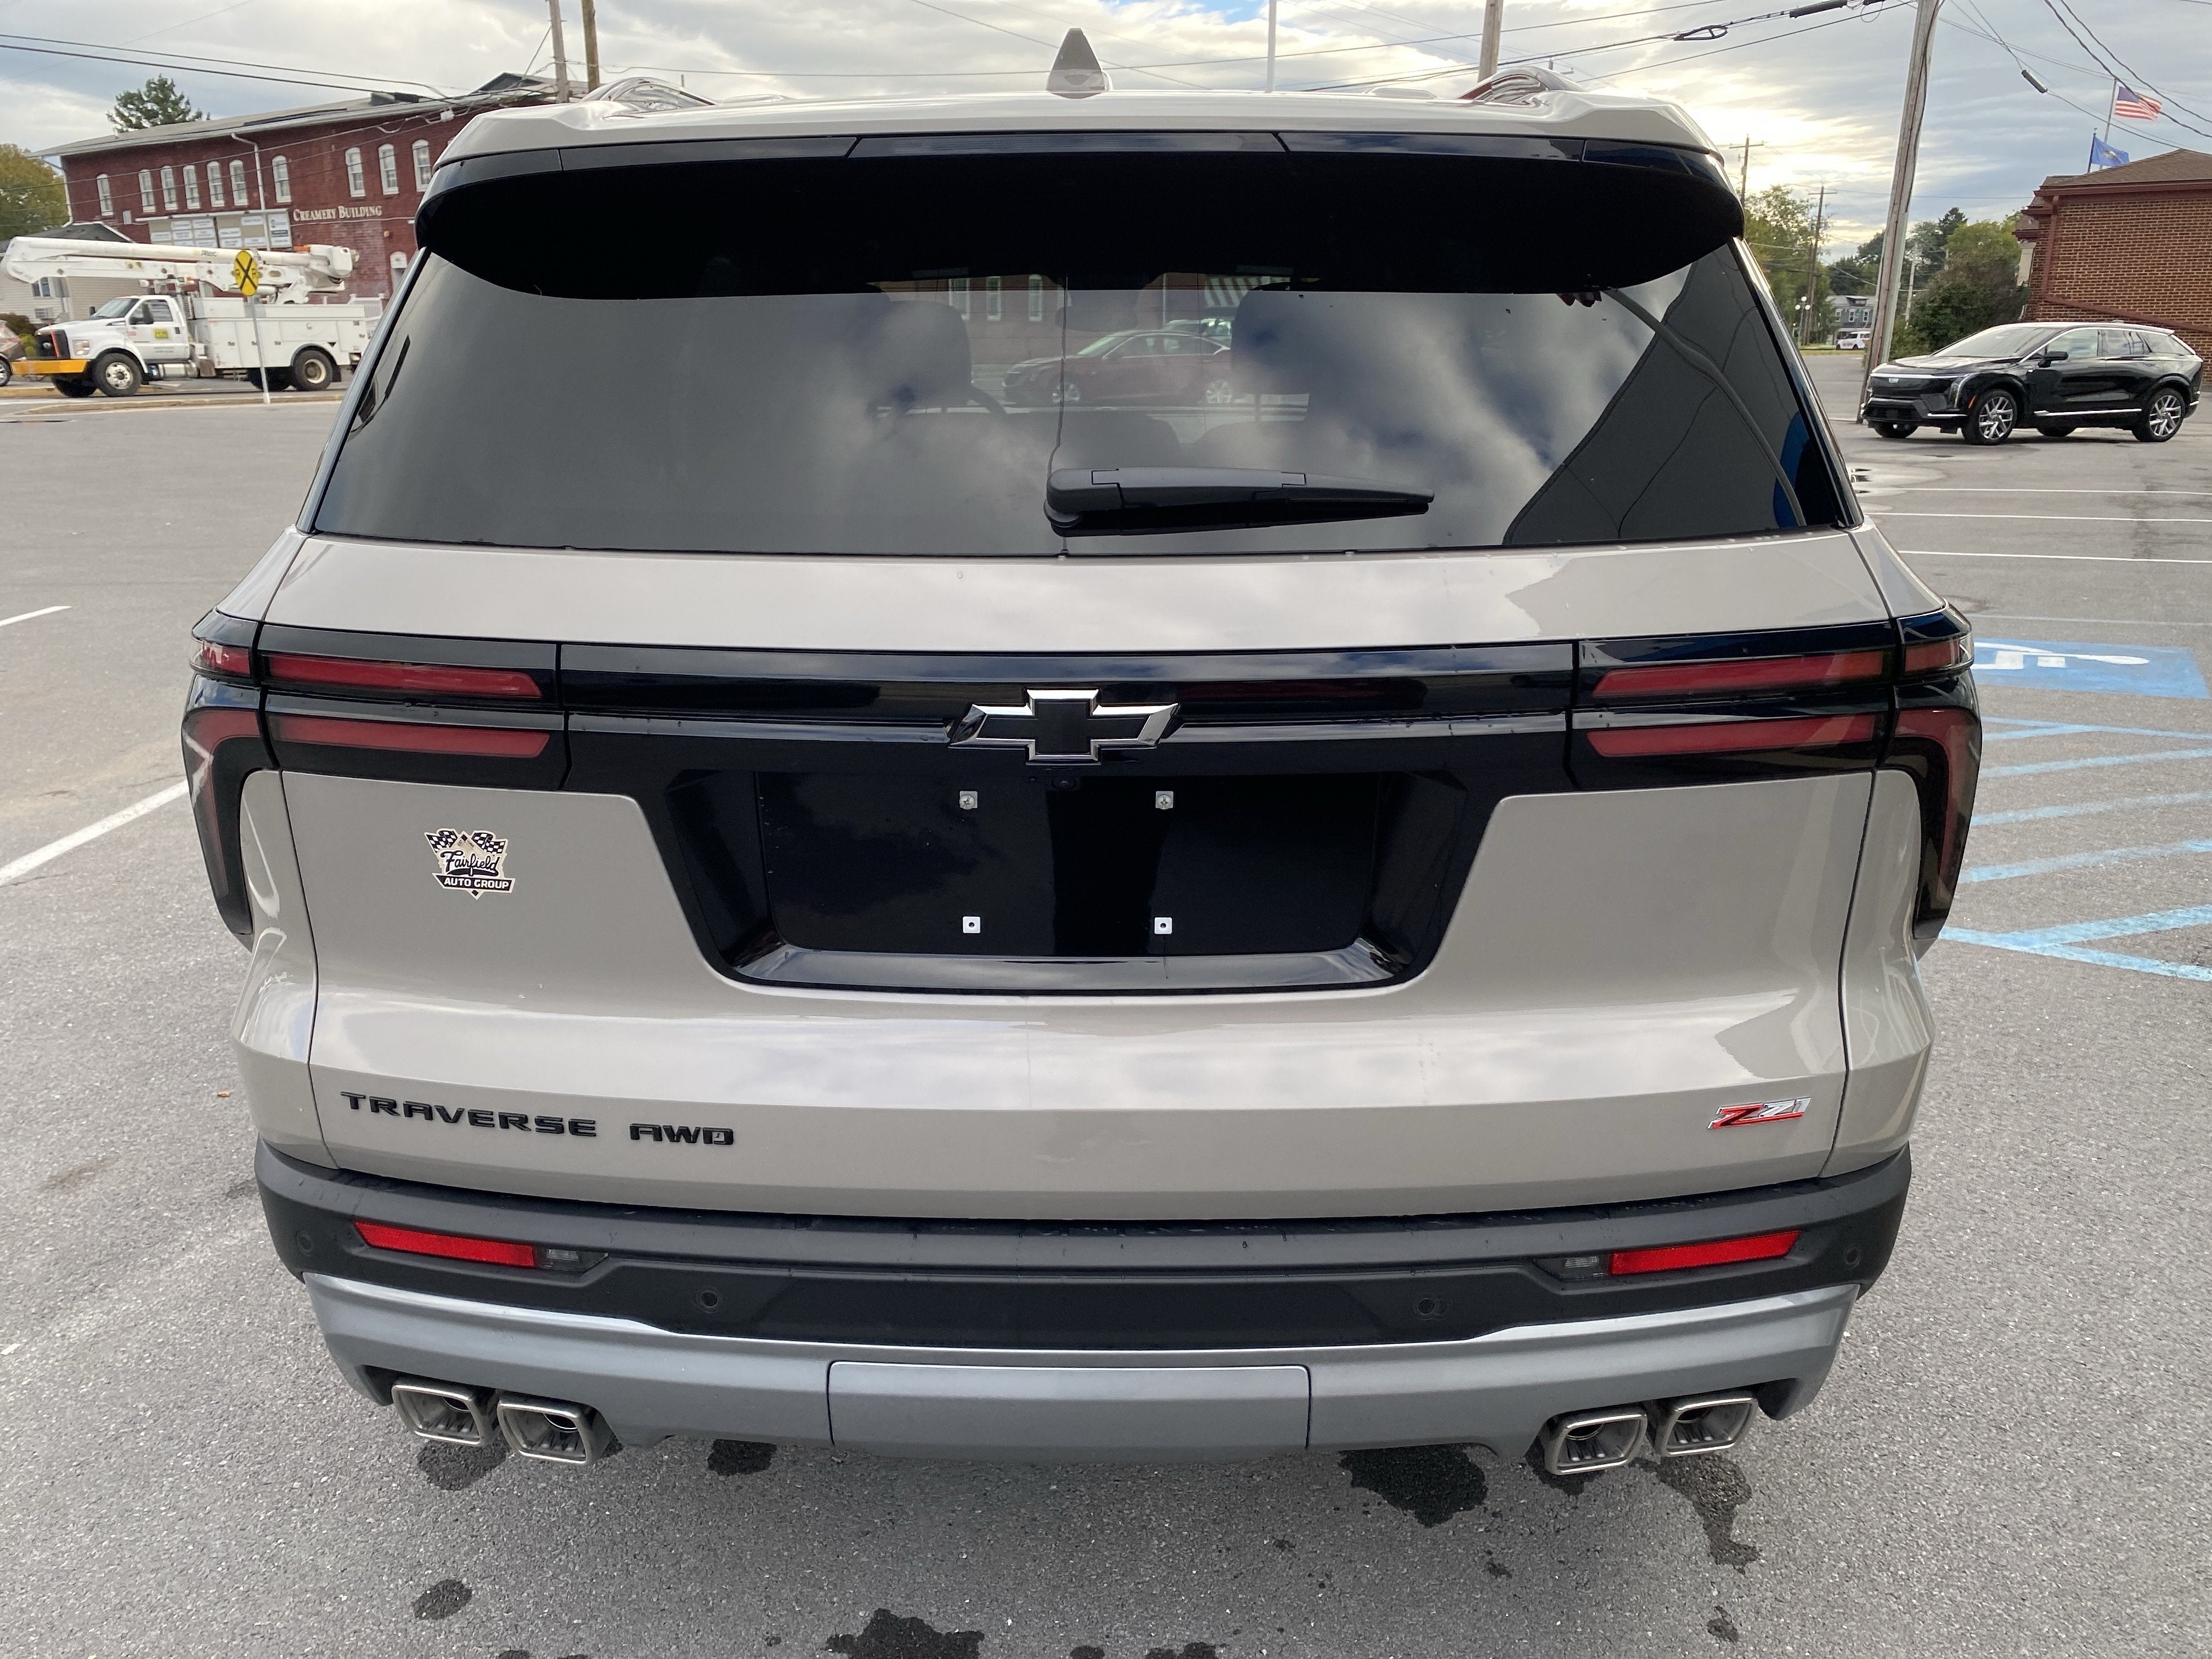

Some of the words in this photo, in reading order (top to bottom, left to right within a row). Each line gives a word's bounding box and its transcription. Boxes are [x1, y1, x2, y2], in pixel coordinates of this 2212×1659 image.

[337, 205, 382, 218] BUILDING
[440, 850, 500, 873] Fairfield
[444, 877, 471, 887] AUTO
[473, 879, 509, 889] GROUP
[340, 1091, 597, 1137] TRAVERSE
[629, 1122, 734, 1146] AWD
